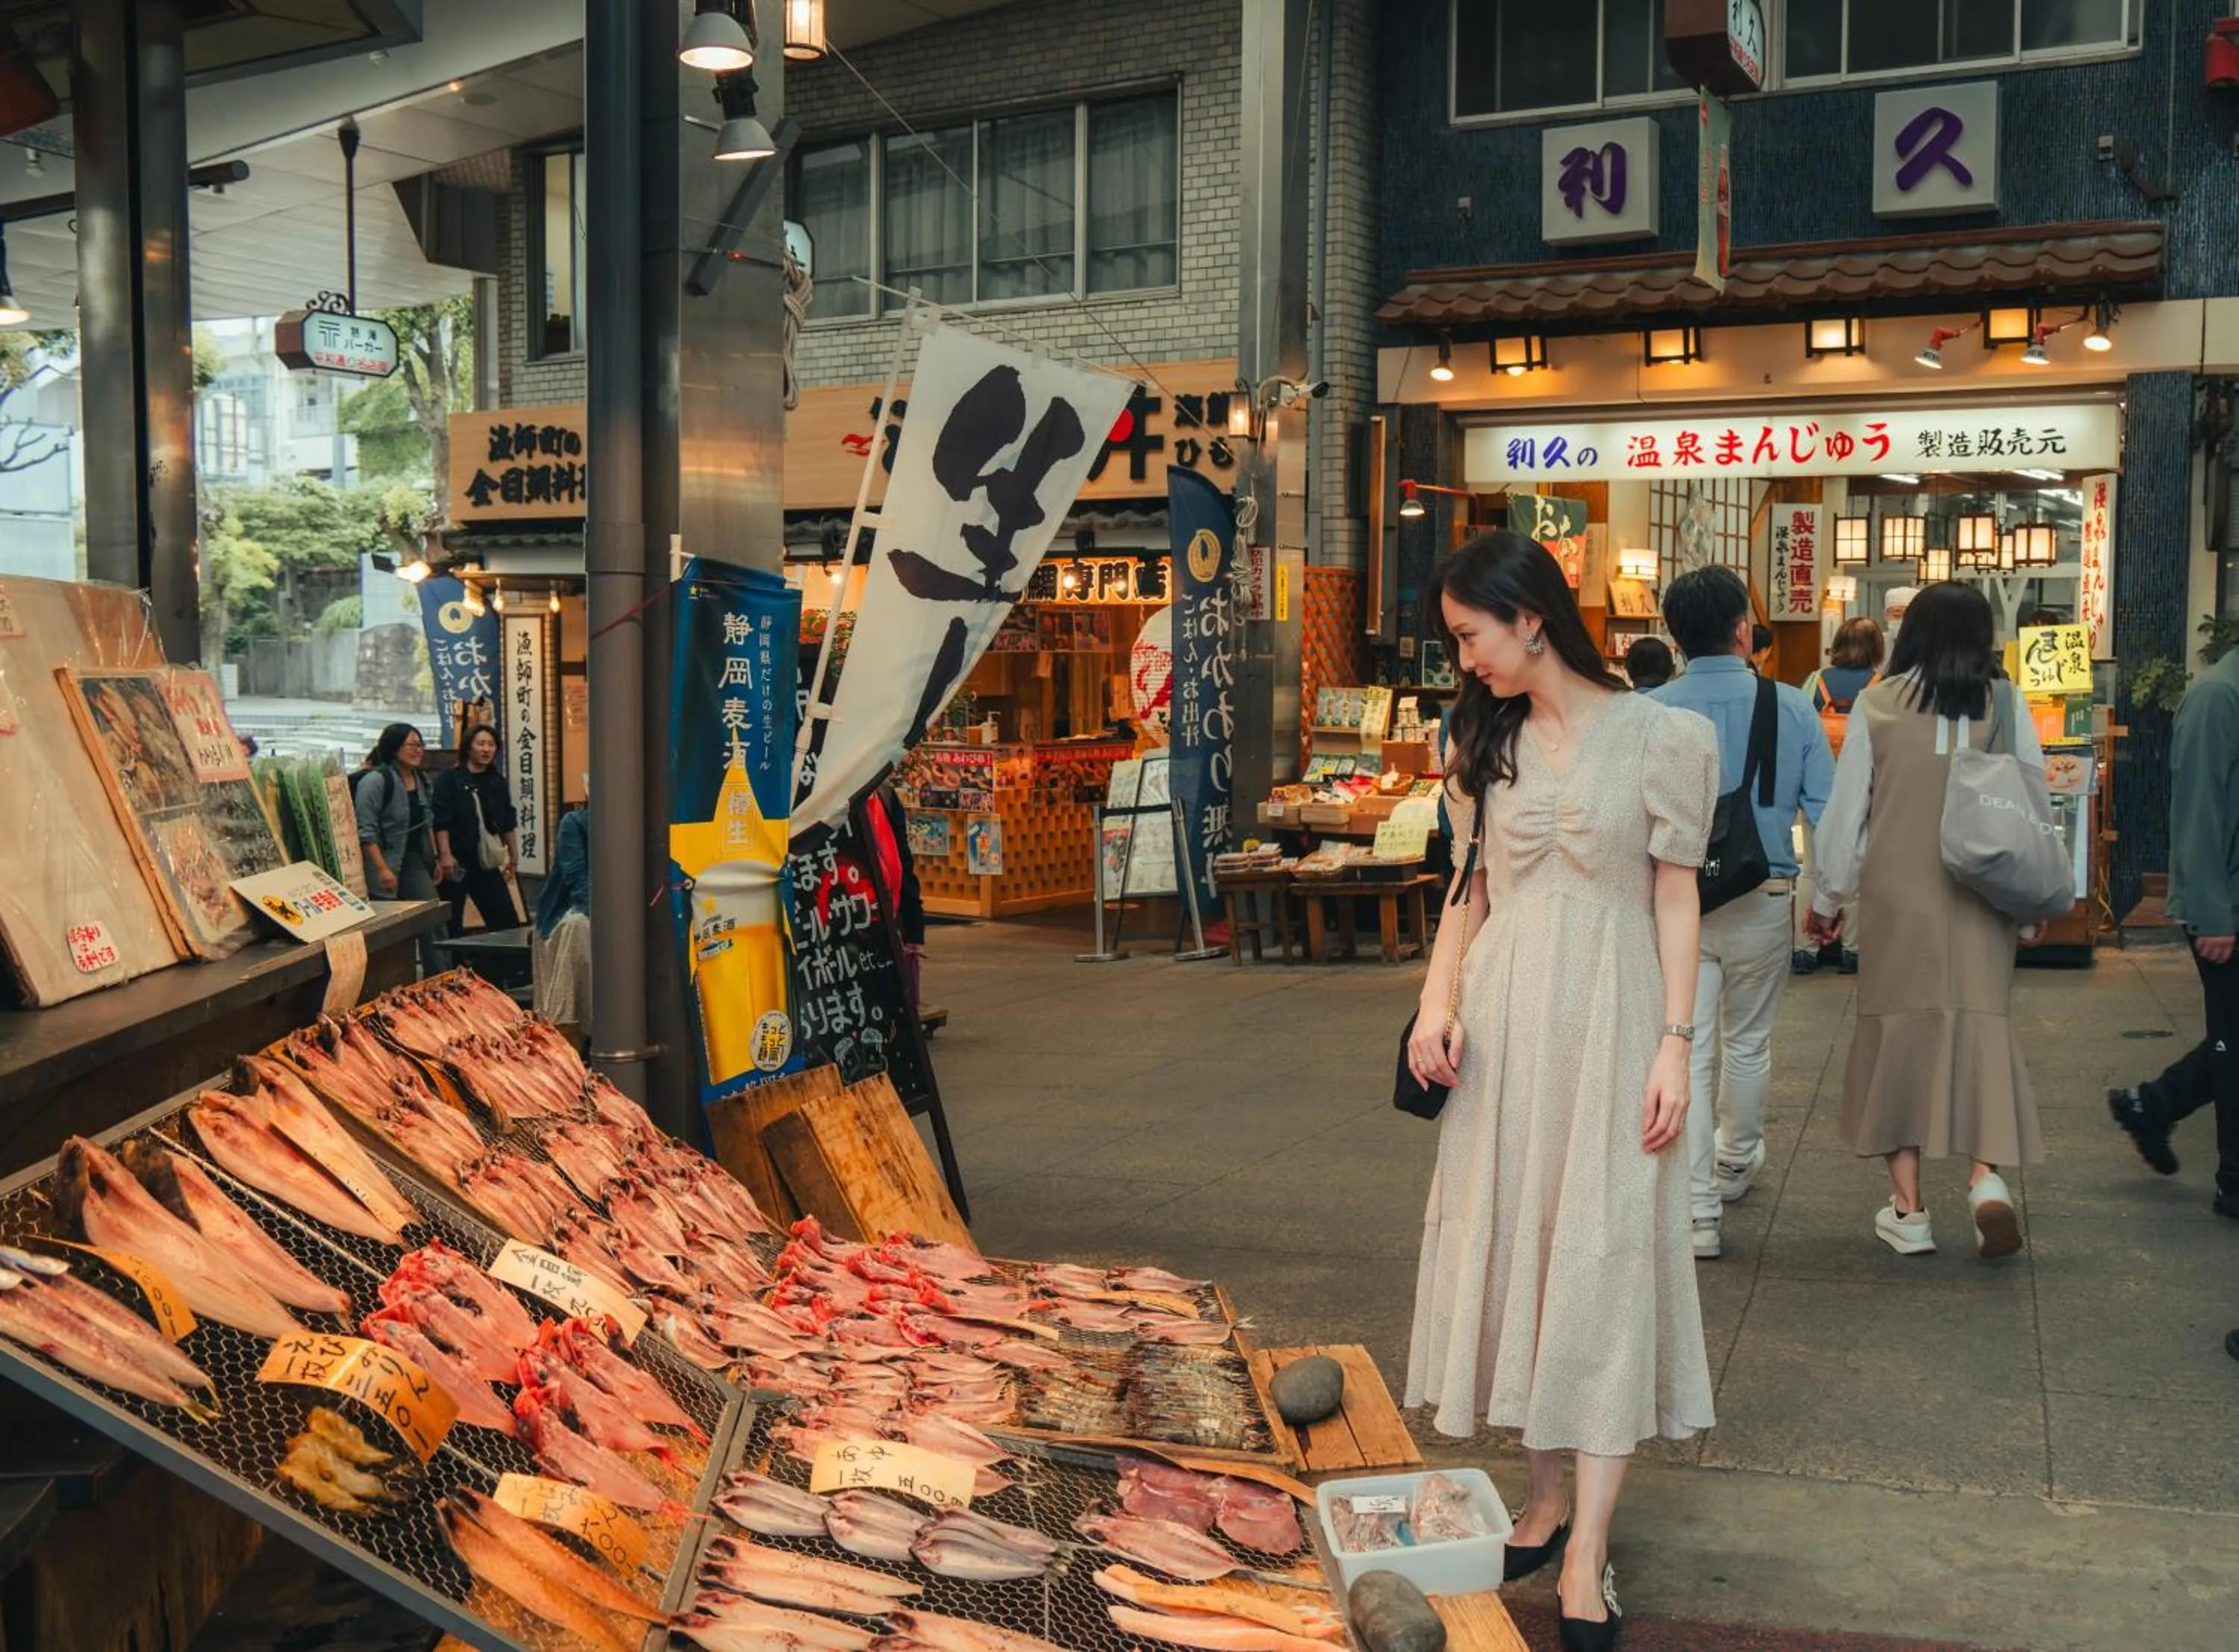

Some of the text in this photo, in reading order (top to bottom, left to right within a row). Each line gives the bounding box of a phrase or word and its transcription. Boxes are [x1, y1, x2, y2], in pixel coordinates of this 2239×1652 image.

[1558, 141, 1628, 219] 利
[1894, 107, 1974, 193] 久
[1506, 422, 2067, 469] 利久の 温泉まんじゅう 製造販売元
[1789, 510, 1815, 614] 製造直売
[717, 611, 753, 771] 静岡麦酒
[2064, 630, 2088, 674] 温泉
[515, 631, 537, 860] 漁師町の金目鯛料理
